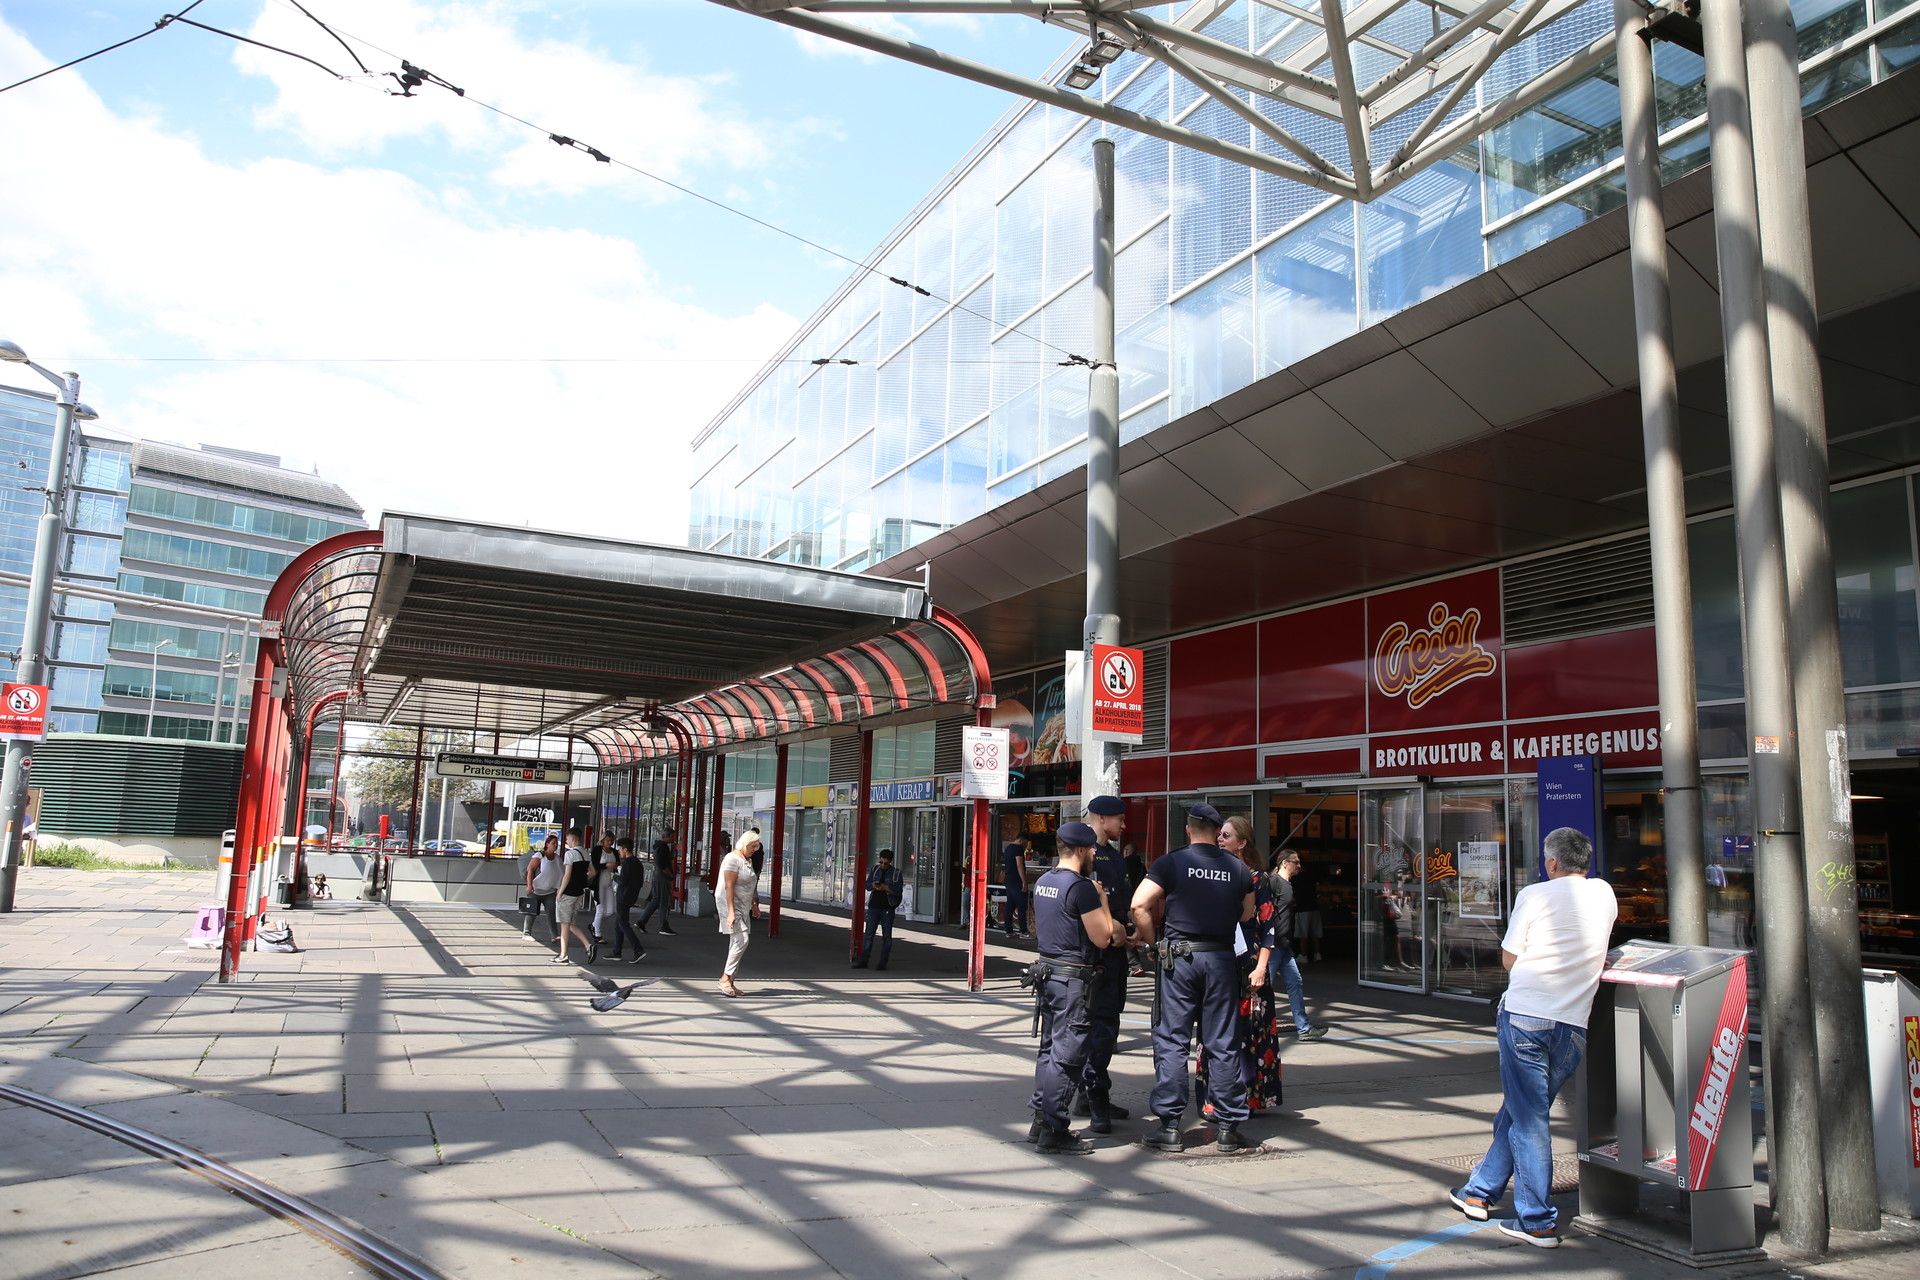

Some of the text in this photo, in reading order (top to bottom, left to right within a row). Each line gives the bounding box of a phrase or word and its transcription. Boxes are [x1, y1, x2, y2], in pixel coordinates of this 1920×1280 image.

[1374, 602, 1496, 709] Geier
[1113, 701, 1128, 710] APRIL
[1095, 708, 1141, 719] ALKOHOLVERBOT
[1095, 716, 1141, 728] AM PRATERSTERN
[1376, 728, 1663, 768] BROTKULTUR & KAFFEEGENUS
[463, 765, 545, 778] Praterstern U1 U2
[897, 783, 923, 800] KEBAP
[1546, 793, 1582, 801] Praterstern
[1188, 867, 1231, 882] POLIZEI
[1035, 885, 1059, 899] POLIZEI
[1690, 1027, 1738, 1140] Heute
